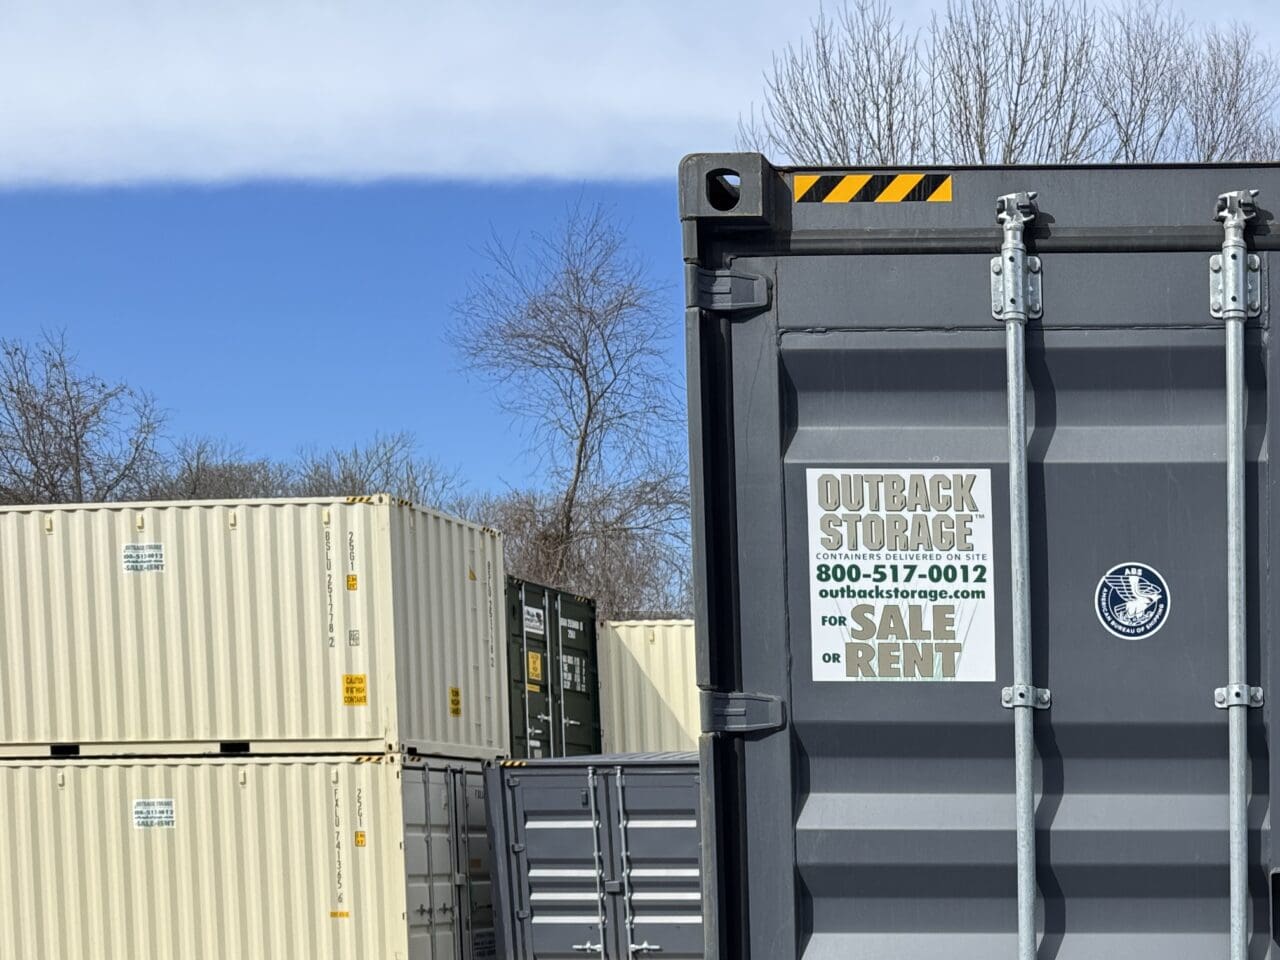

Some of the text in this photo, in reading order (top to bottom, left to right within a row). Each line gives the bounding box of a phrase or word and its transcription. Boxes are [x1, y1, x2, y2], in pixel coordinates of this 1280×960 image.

[817, 474, 979, 512] OUTBACK
[819, 513, 974, 551] STORAGE
[816, 552, 882, 560] CONTAINERS
[946, 553, 961, 561] ON
[966, 553, 988, 561] SITE
[816, 564, 987, 583] 800-517-0012
[1124, 567, 1143, 576] ABS
[818, 585, 986, 601] outbackstorage.com
[821, 603, 956, 640] FOR SALE
[1110, 620, 1135, 634] BUREAU
[1136, 626, 1145, 634] OF
[822, 642, 962, 678] OR RENT
